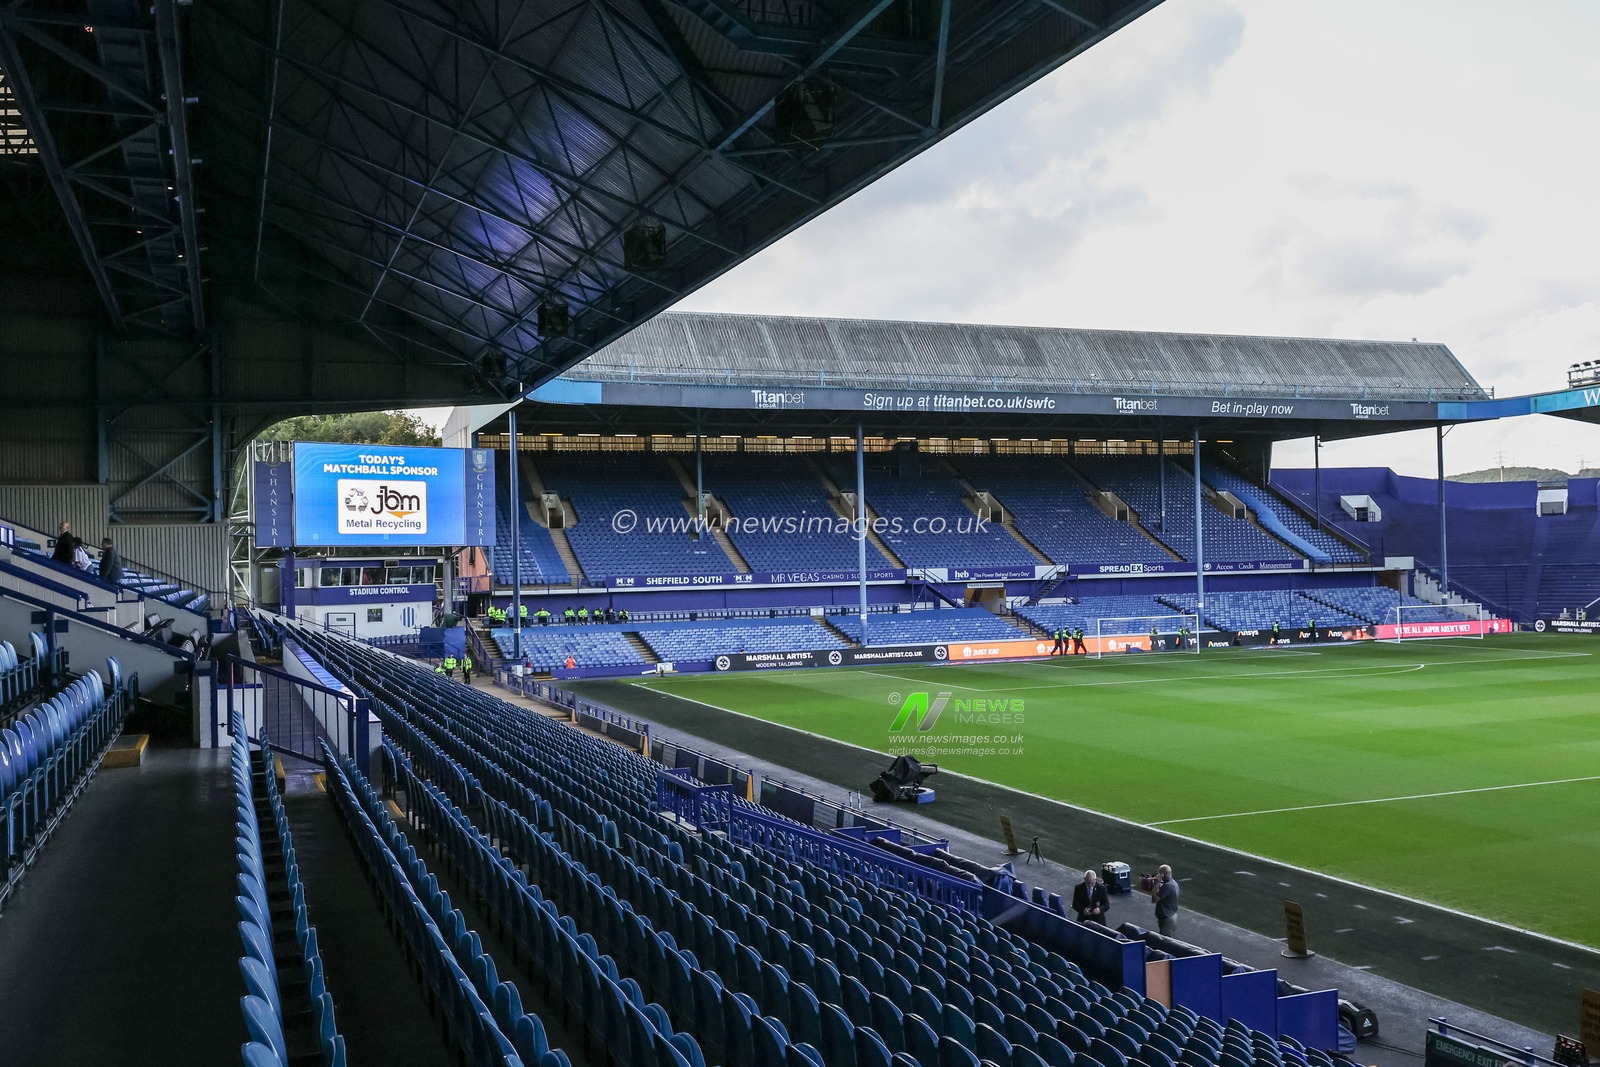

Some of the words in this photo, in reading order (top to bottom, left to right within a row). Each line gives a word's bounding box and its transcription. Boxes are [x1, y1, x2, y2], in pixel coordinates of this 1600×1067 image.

[751, 390, 805, 404] Titanbet
[863, 393, 893, 410] Sign
[897, 397, 914, 410] up
[918, 396, 930, 407] at
[933, 395, 1056, 410] titanbet.co.uk/swfc
[1113, 397, 1158, 410] Titanbet
[1211, 401, 1231, 413] Bet
[1233, 402, 1269, 417] in-play
[1271, 405, 1294, 415] now
[1350, 403, 1390, 416] Titanbet
[358, 454, 405, 465] TODAY'S
[323, 464, 389, 475] MATCHBALL
[390, 466, 438, 476] SPONSOR
[370, 485, 420, 515] jbm
[269, 468, 278, 546] CHANSIRI
[476, 473, 485, 545] CHANSIRI
[346, 519, 373, 529] Metal
[375, 519, 422, 530] Recycling
[1143, 564, 1165, 573] Sports
[1216, 563, 1234, 571] Access
[1238, 562, 1254, 570] Credit
[1259, 561, 1292, 569] Management
[646, 577, 690, 585] SHEFFIELD
[692, 576, 723, 584] SOUTH
[771, 574, 786, 583] MR
[787, 572, 820, 583] VEGAS
[349, 588, 379, 596] STADIUM
[1412, 626, 1422, 634] ALL
[1459, 624, 1471, 632] WE?
[746, 654, 784, 662] MARSHALL
[854, 651, 923, 660] MARSHALLARTIST.CO.UK
[1435, 1039, 1477, 1063] EMERGENCY
